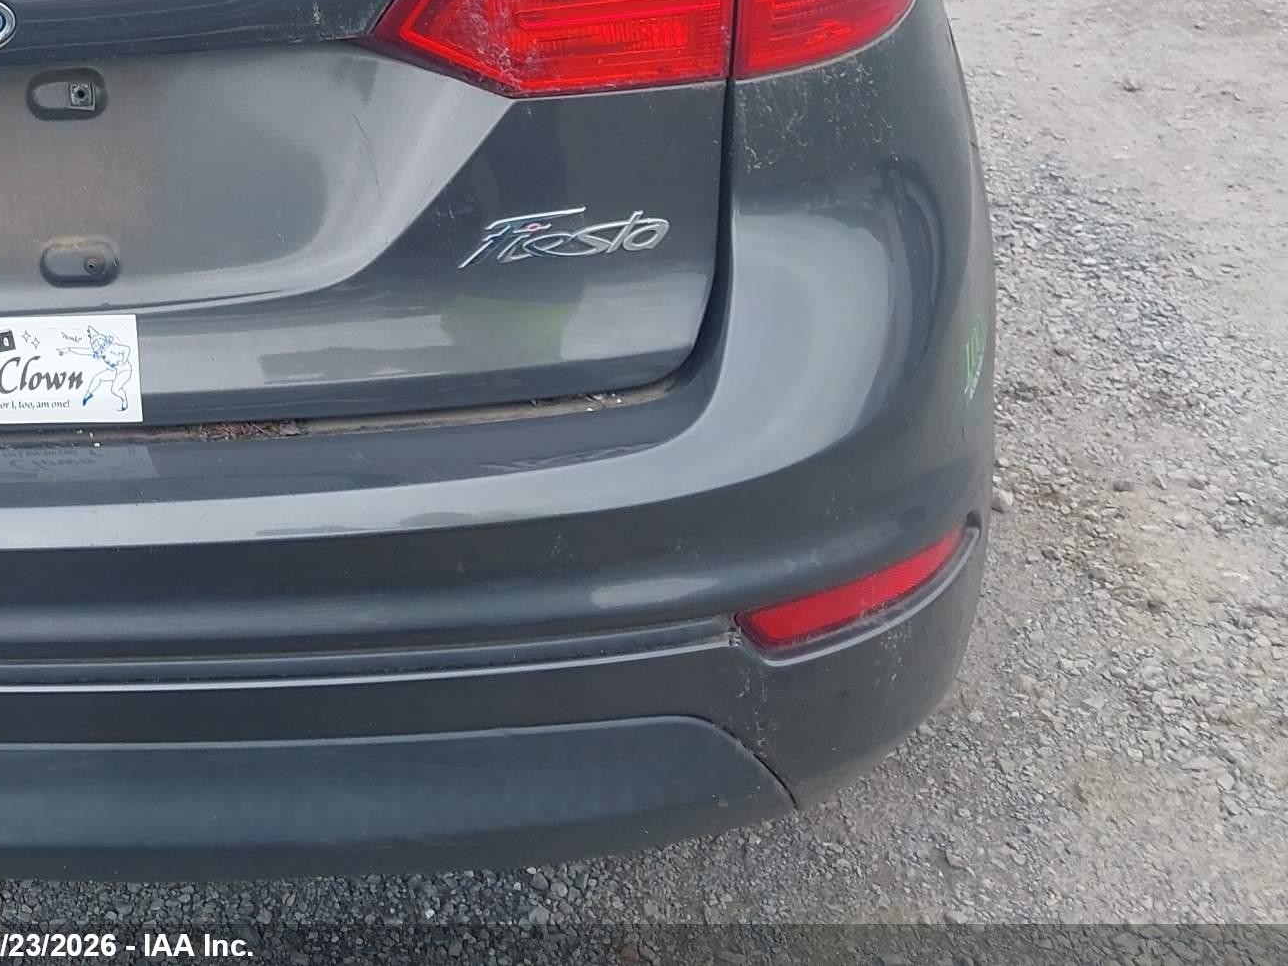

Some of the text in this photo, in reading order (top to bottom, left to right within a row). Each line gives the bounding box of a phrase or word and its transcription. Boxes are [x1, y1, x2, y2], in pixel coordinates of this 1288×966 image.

[458, 206, 669, 269] Fiesta
[3, 336, 10, 347] a
[18, 400, 35, 410] too,
[36, 401, 50, 409] am
[51, 399, 70, 409] one!
